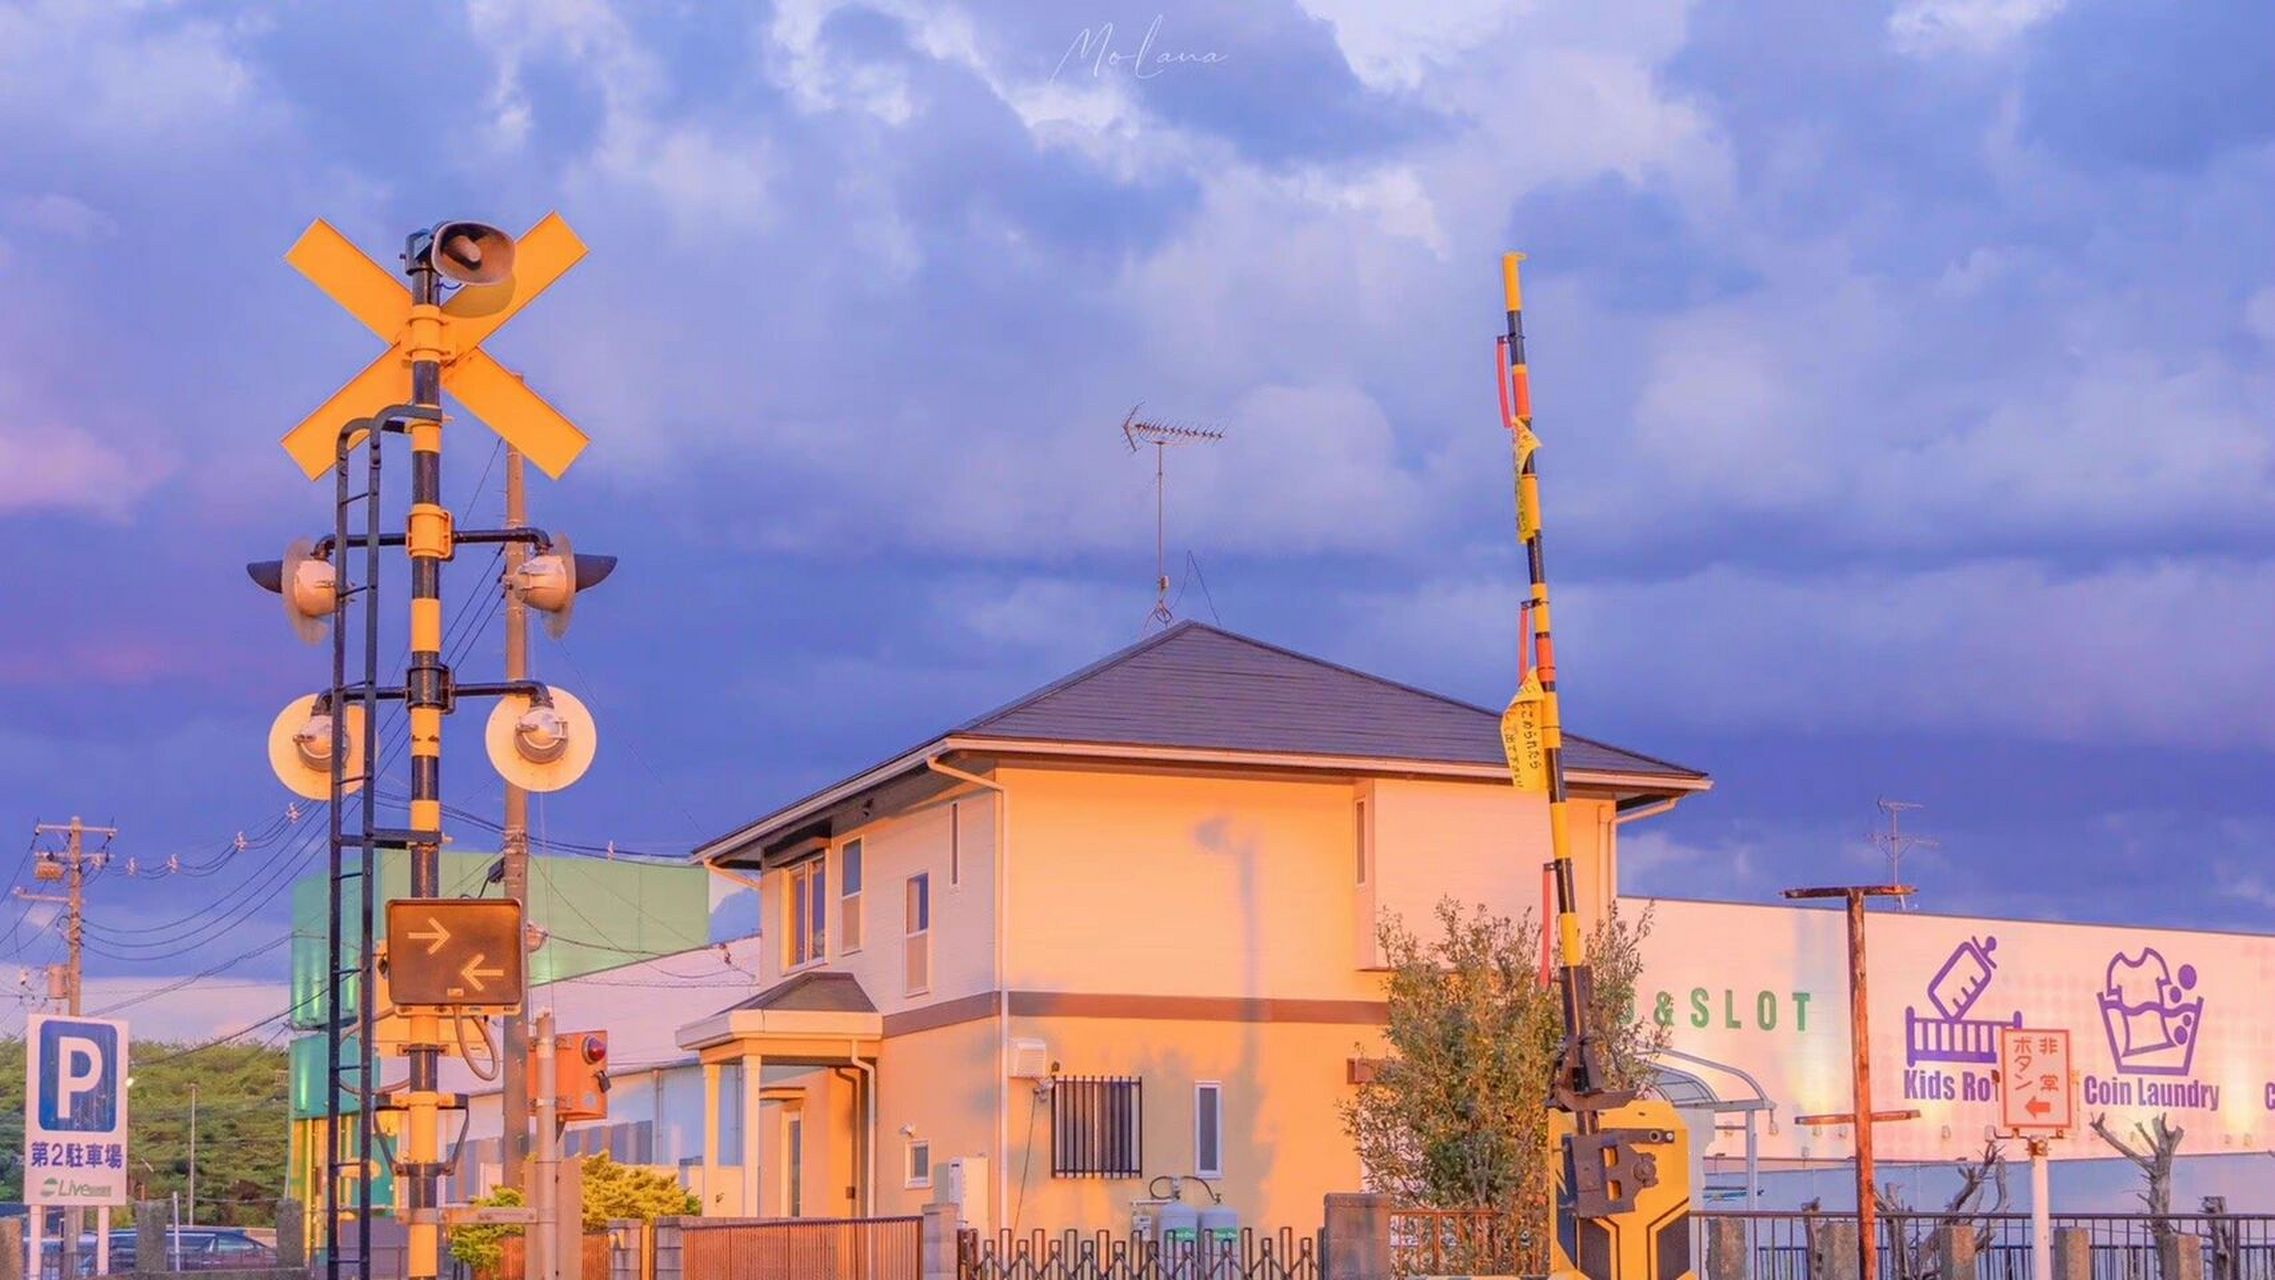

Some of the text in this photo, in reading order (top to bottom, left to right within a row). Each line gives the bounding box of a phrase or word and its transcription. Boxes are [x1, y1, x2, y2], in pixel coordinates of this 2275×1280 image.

[57, 1036, 103, 1119] P
[1904, 1069, 1991, 1102] Kids Ro
[2083, 1075, 2220, 1111] Coin Laundry
[31, 1141, 123, 1169] 第2駐車場
